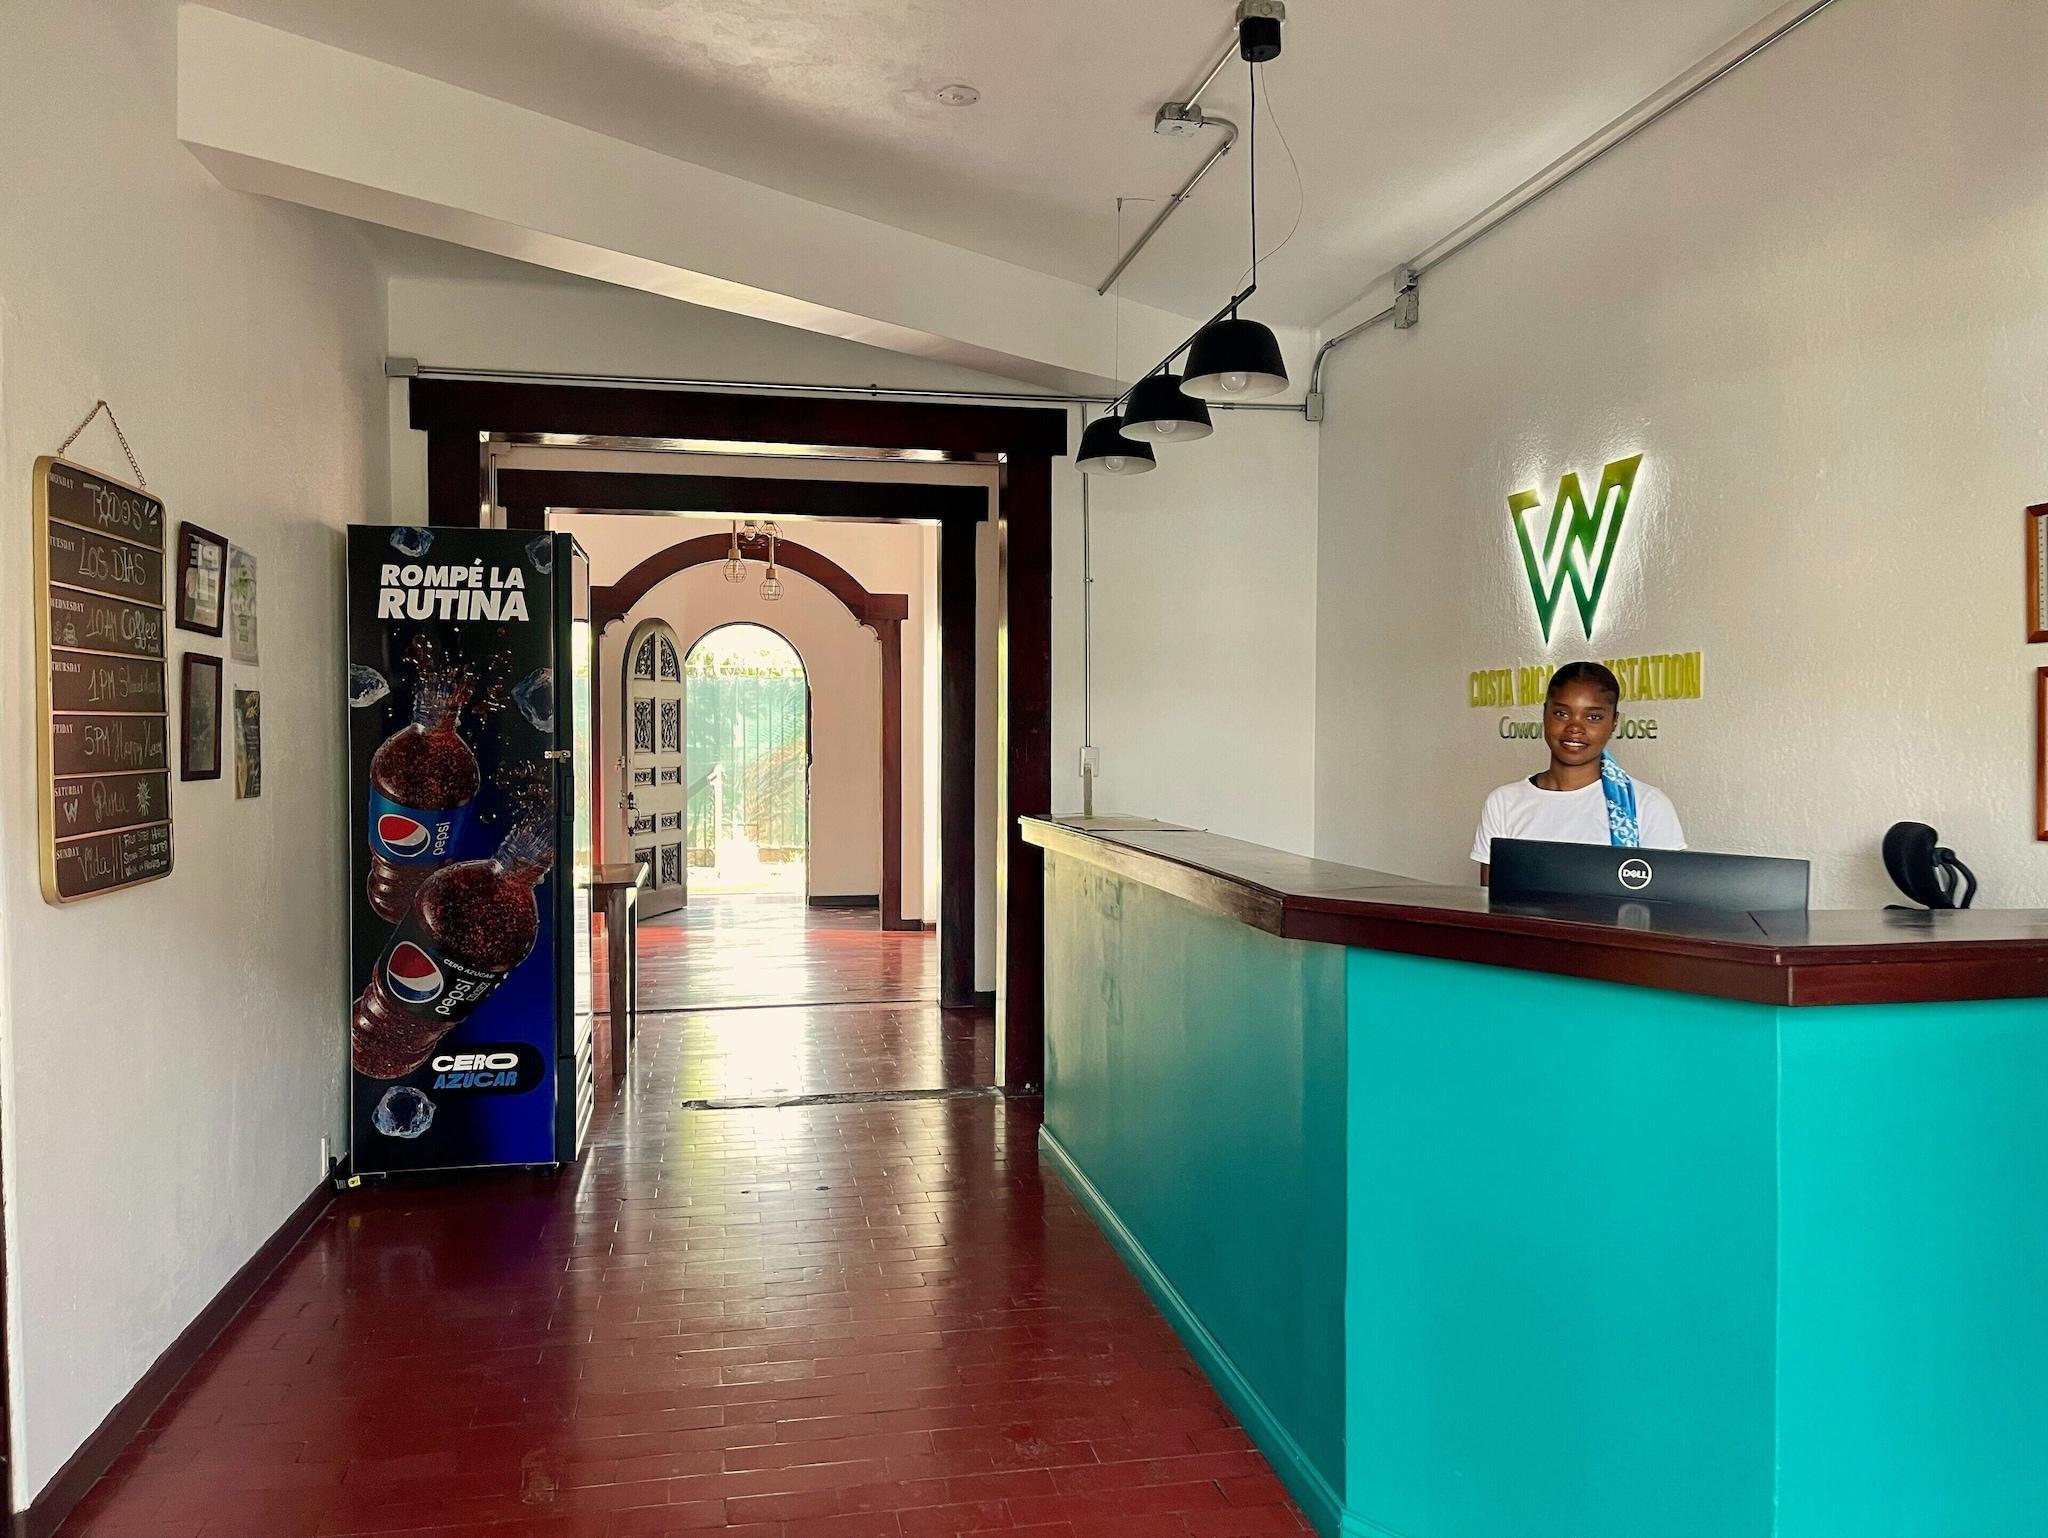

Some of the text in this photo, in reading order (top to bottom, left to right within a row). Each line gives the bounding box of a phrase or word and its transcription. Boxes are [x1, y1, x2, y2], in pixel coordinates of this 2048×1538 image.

[50, 472, 75, 489] MONDAY
[50, 536, 75, 551] TUESDAY
[78, 537, 109, 580] LOS
[381, 558, 525, 589] ROMPÉ LA
[51, 598, 85, 613] WEDNESDAY
[377, 588, 530, 622] RUTINA
[121, 609, 158, 650] Coffee
[52, 661, 81, 673] THURSDAY
[88, 668, 116, 702] 1PM
[1469, 669, 1514, 708] COSTA
[1603, 651, 1701, 701] STATION
[53, 723, 74, 734] FRIDAY
[1500, 715, 1543, 740] Cowor
[84, 725, 110, 757] 5PM
[54, 784, 83, 797] SATURDAY
[433, 822, 450, 856] pepsi
[56, 846, 80, 860] SUNDAY
[1622, 868, 1648, 879] DELL
[443, 958, 464, 972] CERO
[435, 978, 475, 1016] pepsi
[432, 1053, 519, 1072] CERO
[433, 1071, 518, 1090] AZÚCAR
